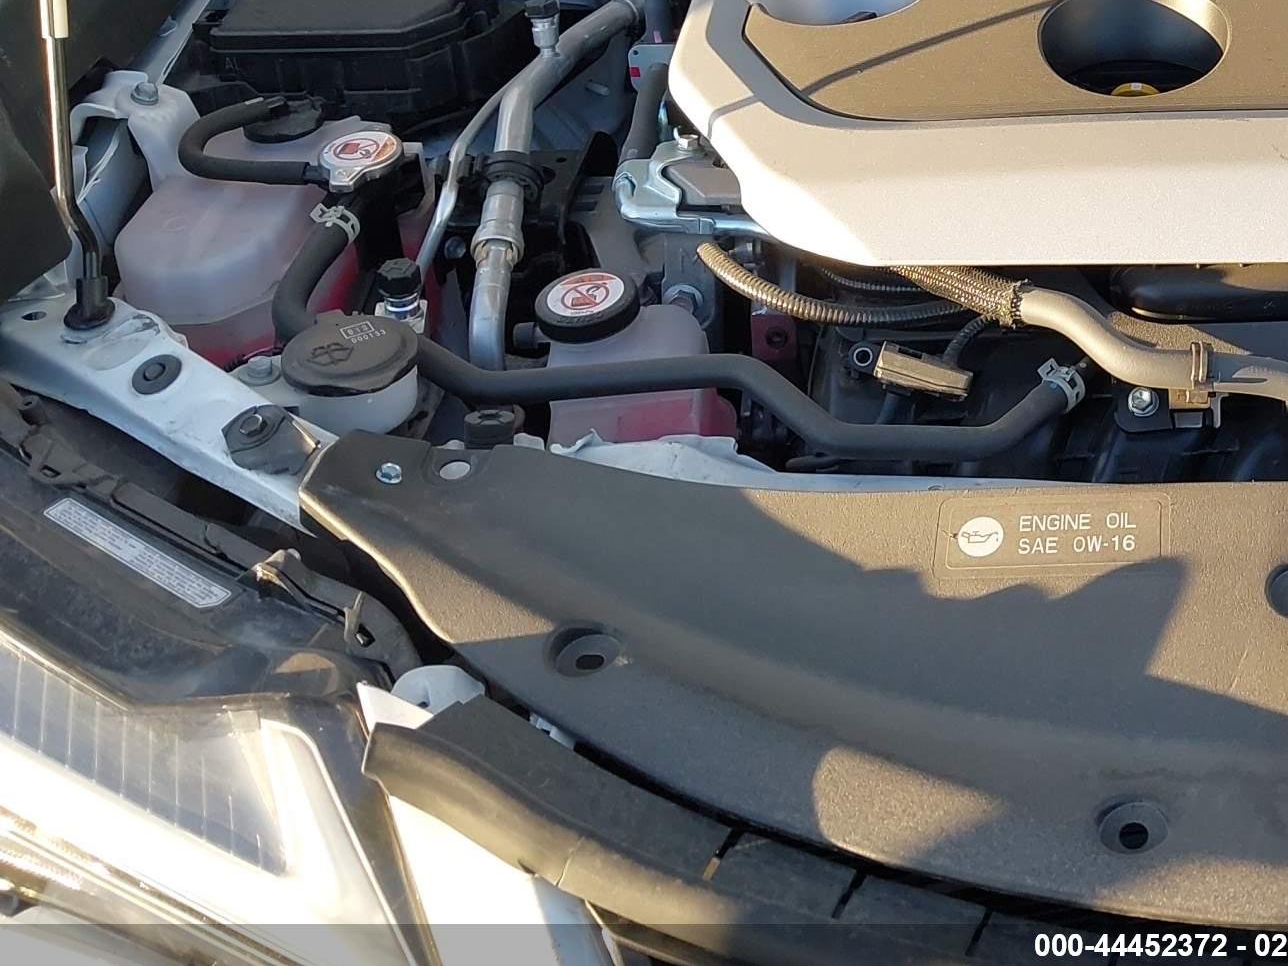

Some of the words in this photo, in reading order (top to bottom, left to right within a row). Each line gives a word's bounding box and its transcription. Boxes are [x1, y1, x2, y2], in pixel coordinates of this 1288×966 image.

[1020, 514, 1091, 531] ENGINE
[1106, 512, 1136, 530] OIL
[1018, 537, 1058, 554] SAE
[1073, 534, 1136, 553] 0W-16
